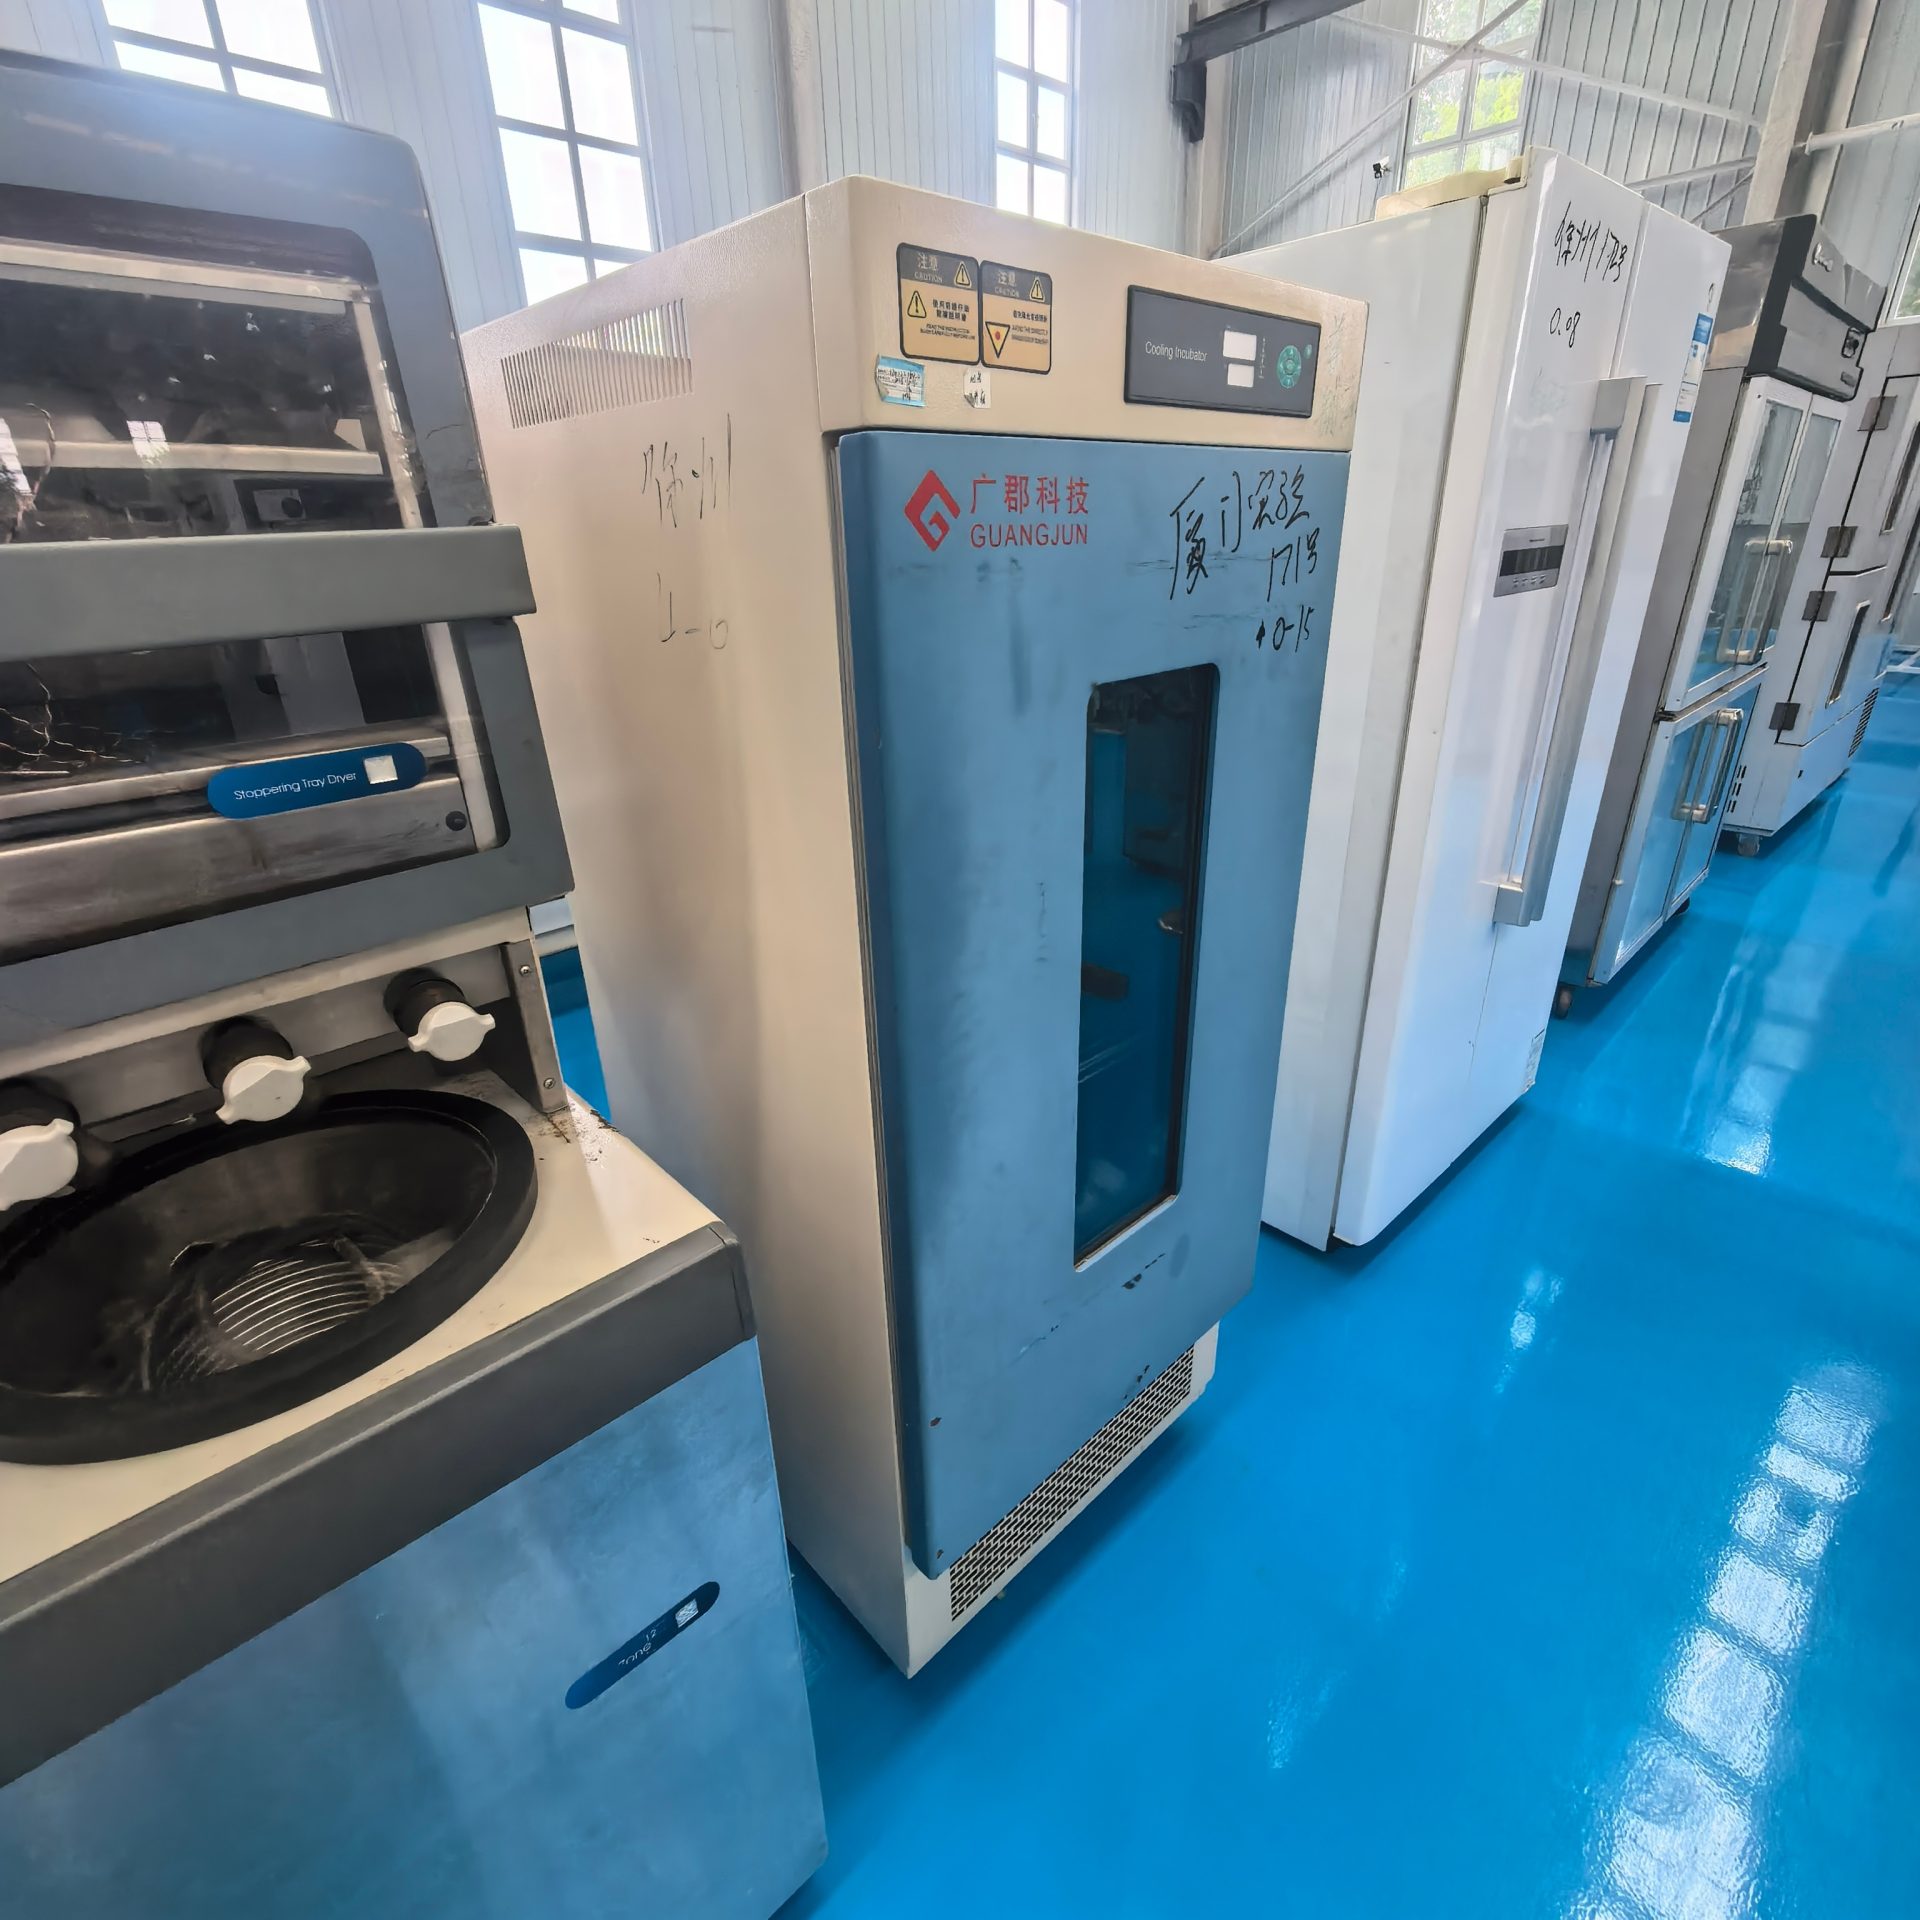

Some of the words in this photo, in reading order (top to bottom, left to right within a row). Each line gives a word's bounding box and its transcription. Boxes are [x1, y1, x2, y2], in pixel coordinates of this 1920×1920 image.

[914, 271, 943, 283] CAUTION
[1145, 341, 1173, 360] Cooling
[1175, 346, 1207, 361] Incubator
[970, 474, 1088, 515] 广郡科技
[970, 523, 1088, 548] GUANGJUN
[234, 781, 300, 800] Stoppering
[301, 777, 326, 789] Tray
[327, 772, 357, 784] Dryer
